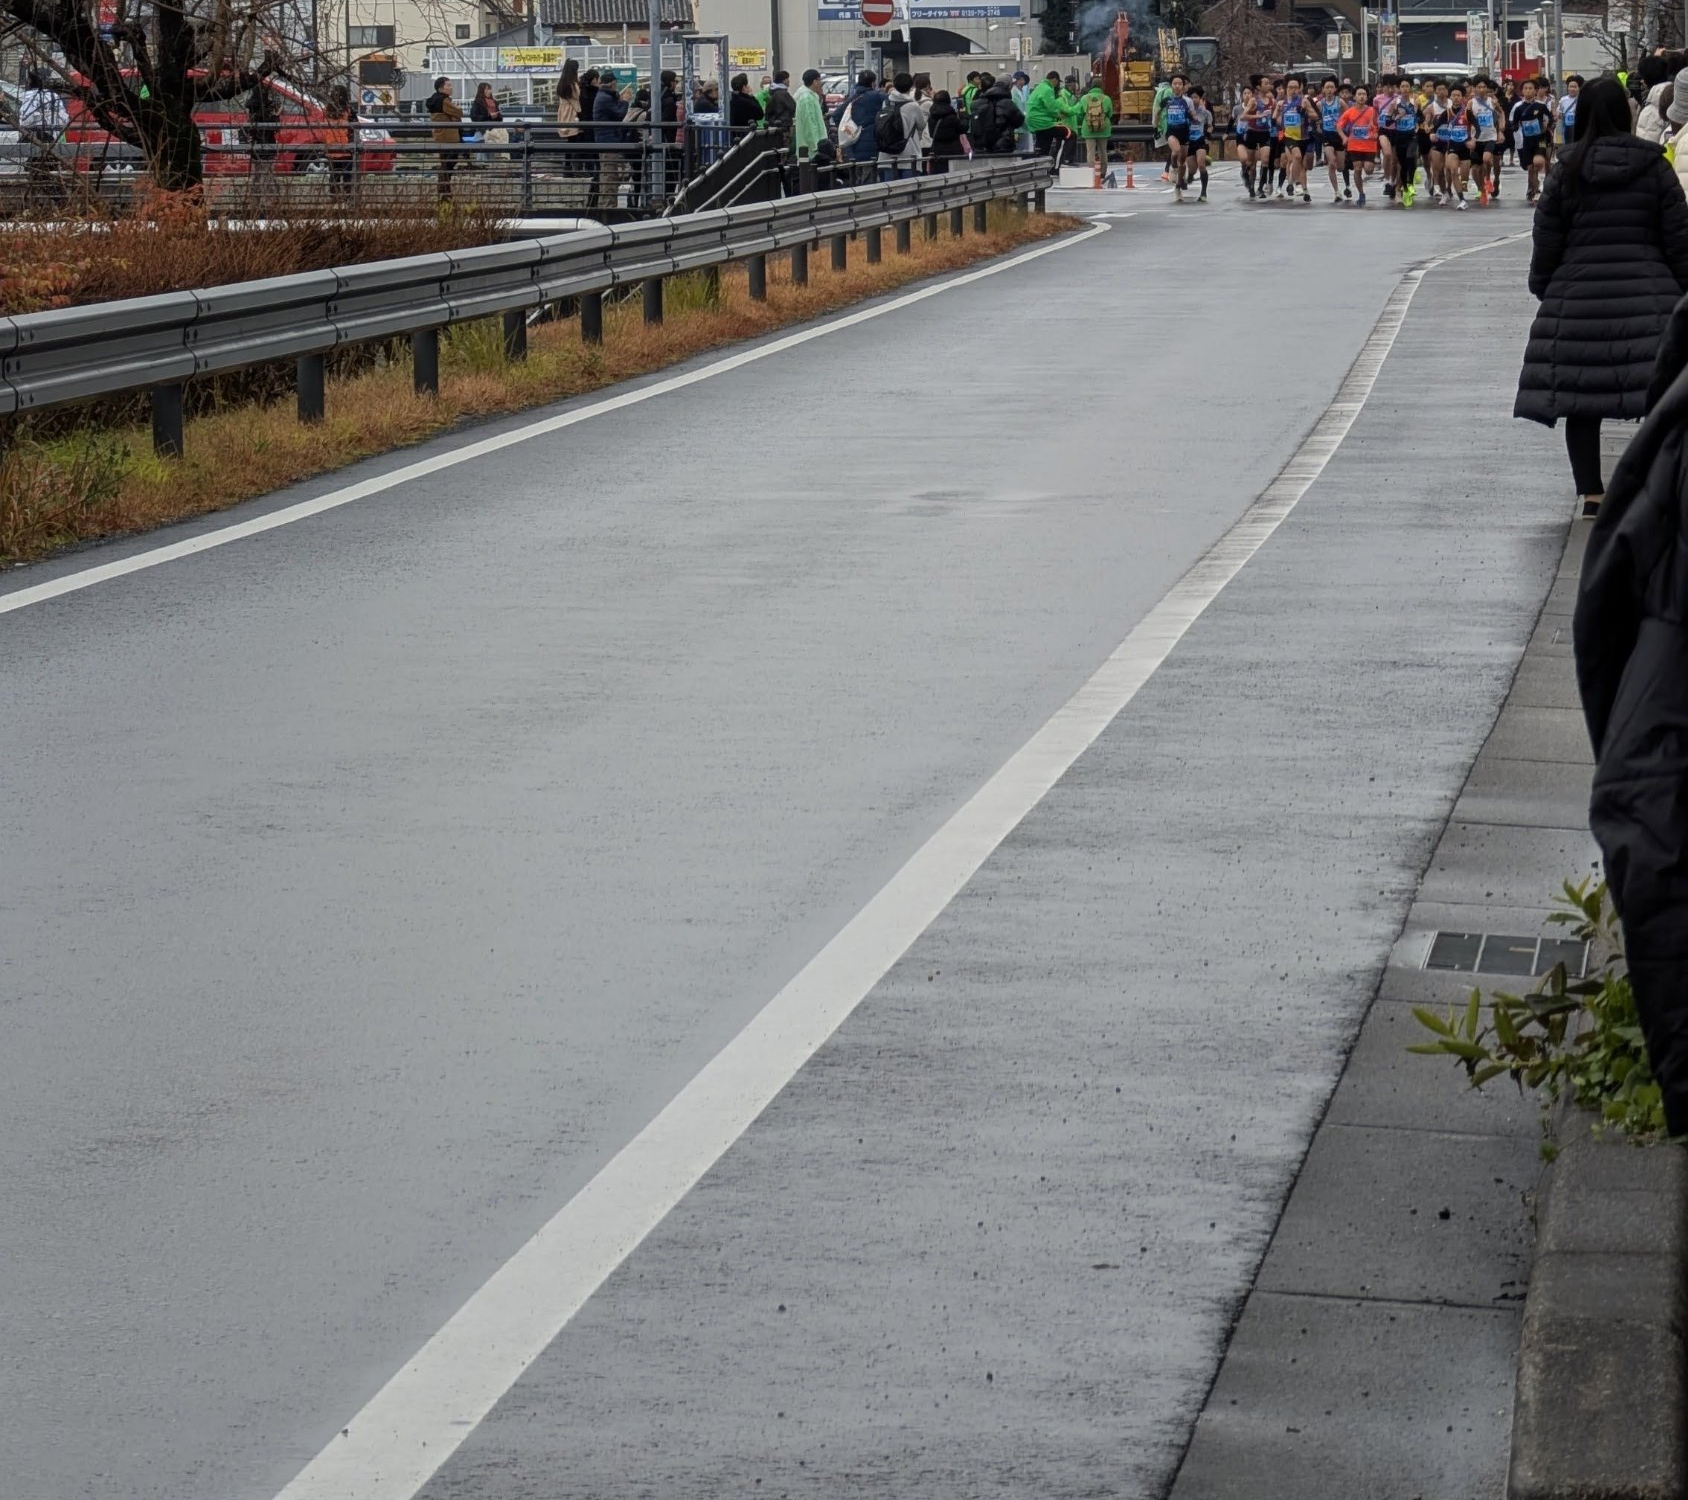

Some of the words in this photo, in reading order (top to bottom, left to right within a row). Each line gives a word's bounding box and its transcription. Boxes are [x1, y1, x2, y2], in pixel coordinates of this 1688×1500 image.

[911, 10, 948, 18] フリーダイヤル
